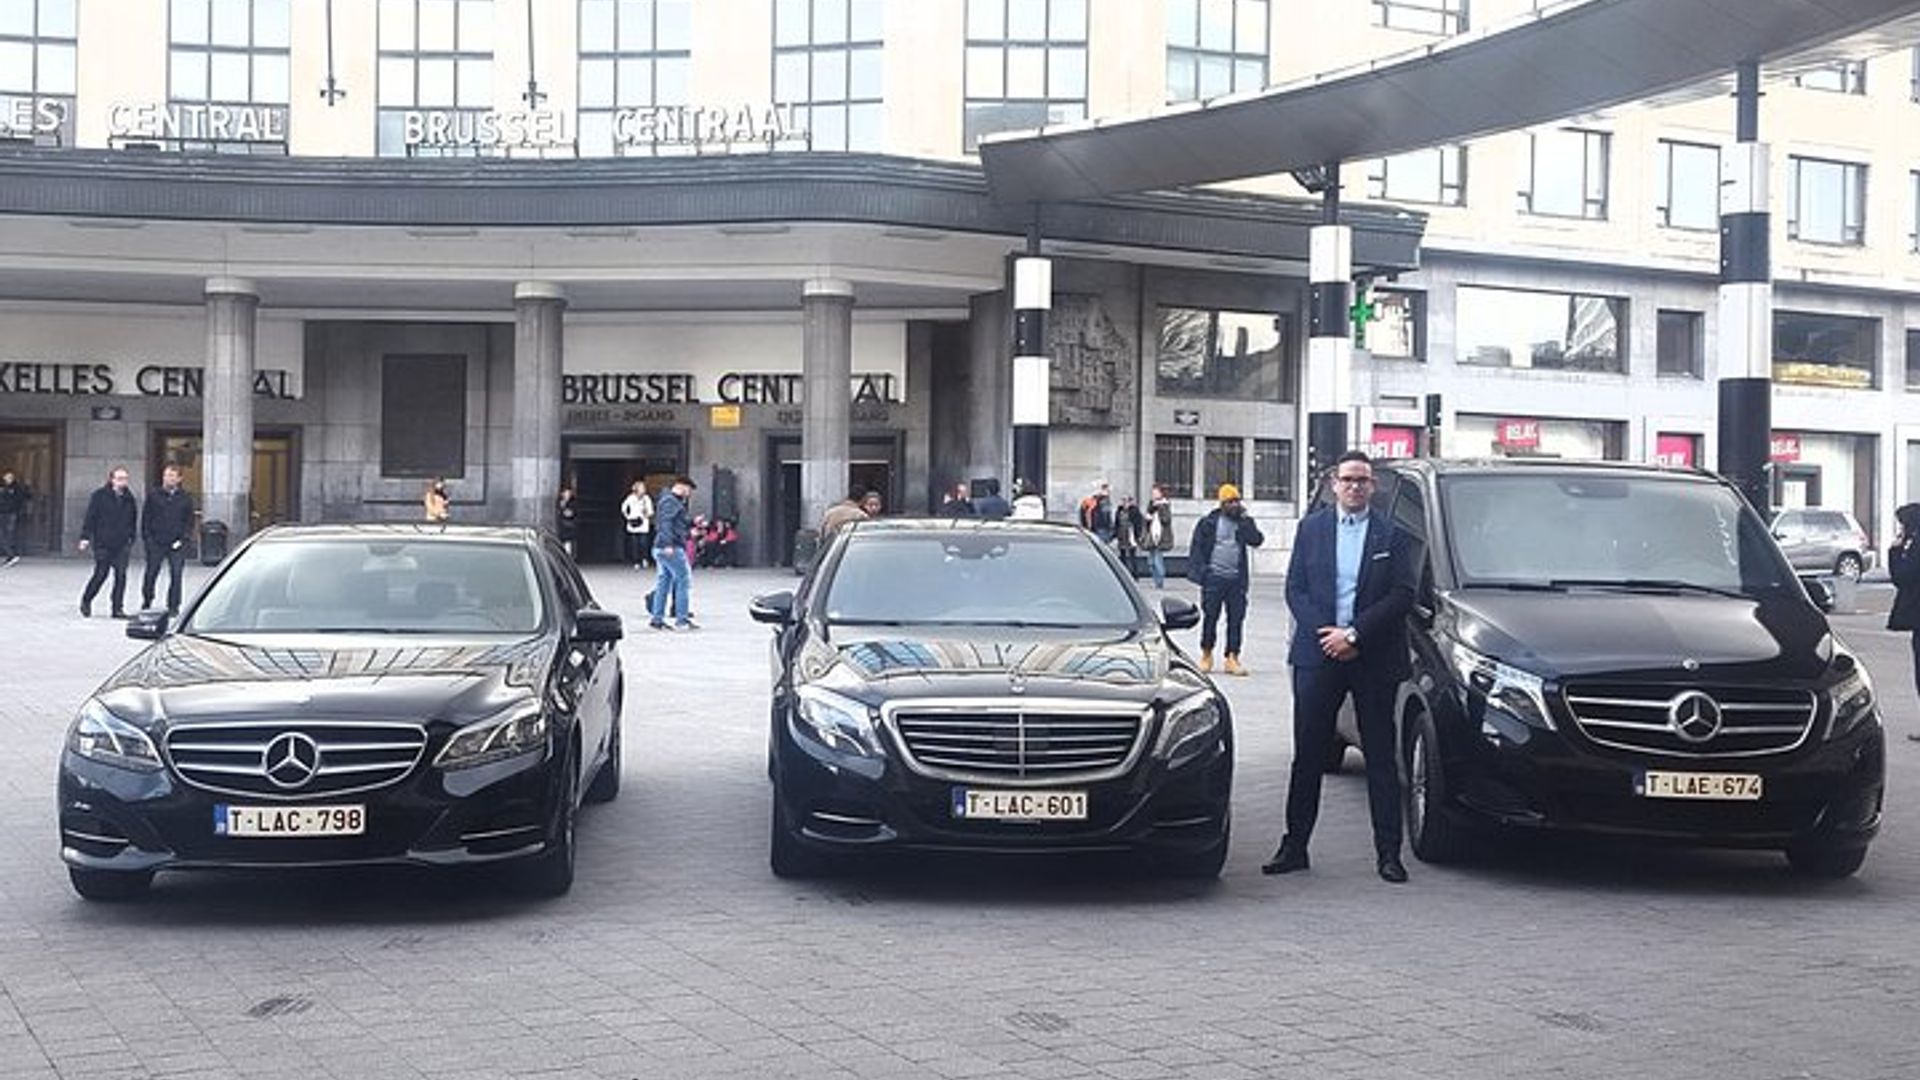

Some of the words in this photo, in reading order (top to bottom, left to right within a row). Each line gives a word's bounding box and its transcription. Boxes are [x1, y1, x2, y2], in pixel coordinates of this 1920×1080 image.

[0, 97, 68, 130] ES
[107, 102, 285, 140] CENTRAL
[403, 107, 575, 145] BRUSSEL
[614, 101, 810, 141] CENTRAAL
[136, 365, 296, 400] CENAL
[561, 374, 700, 403] BRUSSEL
[716, 372, 901, 404] CENTAL
[230, 809, 362, 832] T-LAC-798
[968, 793, 1084, 815] T-LAC-601
